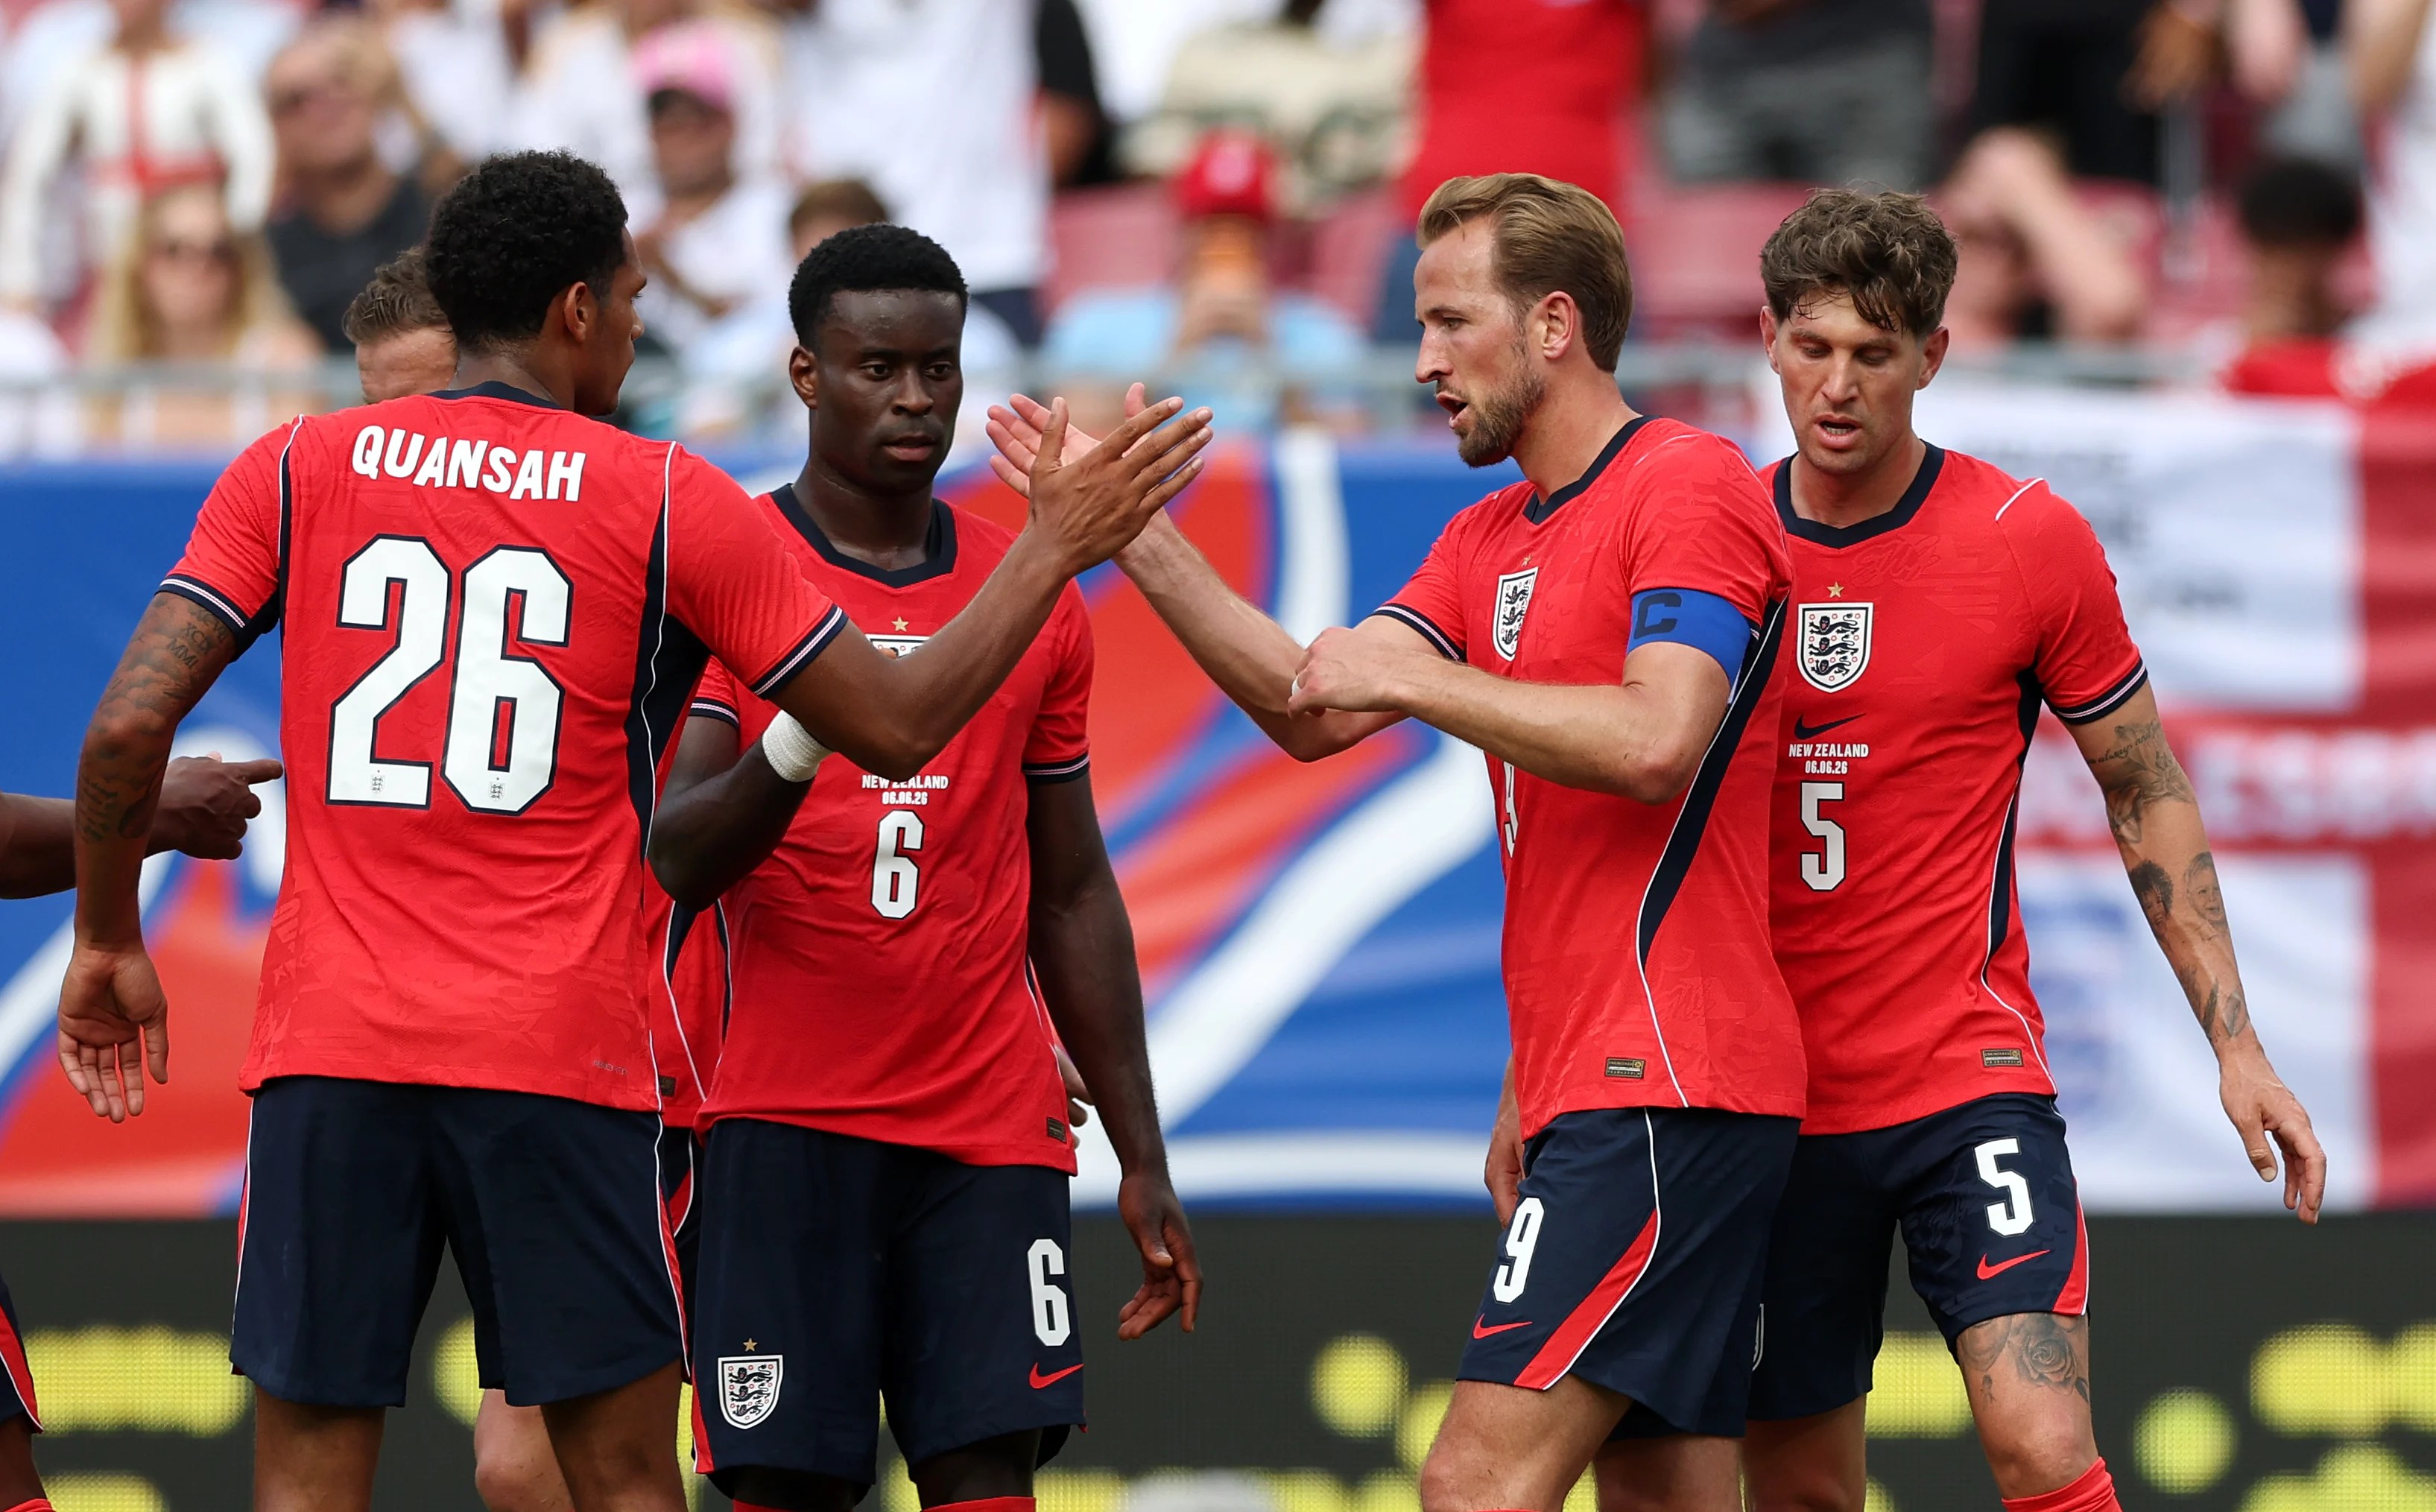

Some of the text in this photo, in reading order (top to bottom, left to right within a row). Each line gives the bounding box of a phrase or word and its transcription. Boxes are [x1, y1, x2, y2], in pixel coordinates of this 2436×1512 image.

[352, 425, 586, 502] QUANSAH
[1633, 592, 1682, 639] C
[326, 534, 573, 814] 26
[861, 774, 890, 788] NEW
[1788, 744, 1869, 758] NEW ZEALAND
[1805, 760, 1848, 774] 06.06.26
[882, 791, 928, 806] 06.06.26
[1800, 781, 1846, 891] 5
[871, 810, 924, 920] 6
[1973, 1137, 2035, 1237] 5
[1027, 1239, 1071, 1347] 6
[1493, 1197, 1545, 1303] 9
